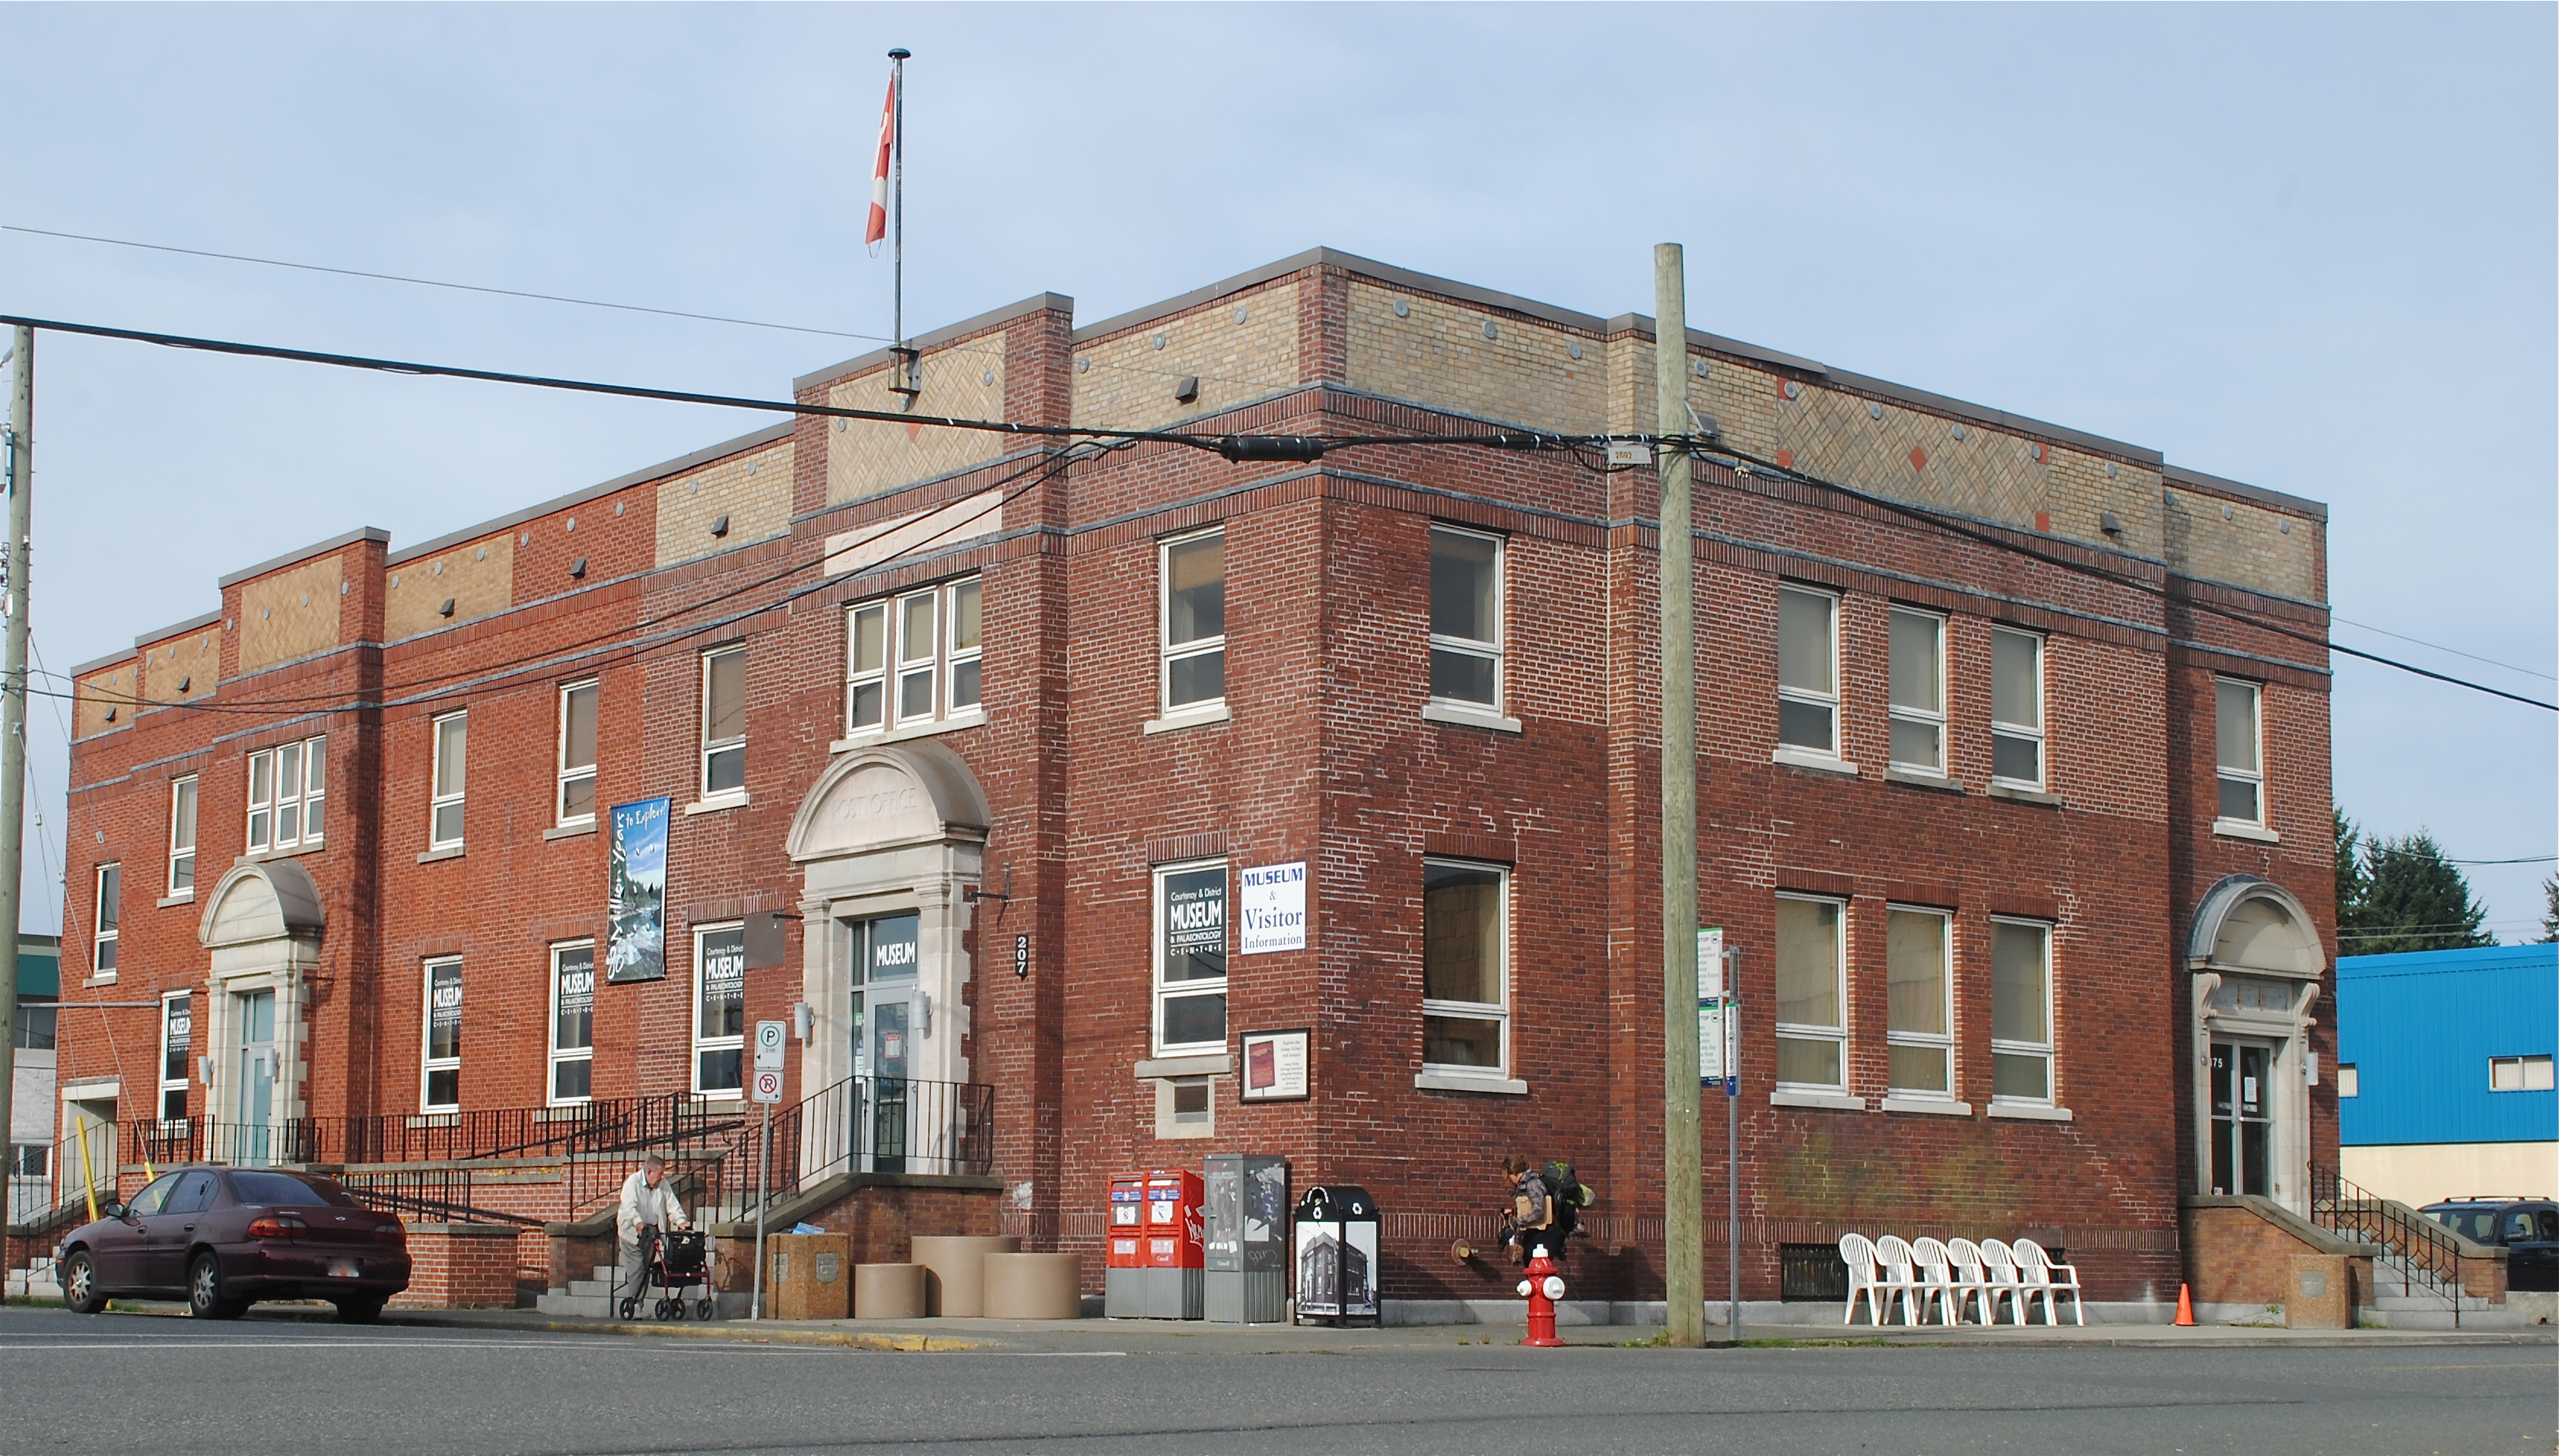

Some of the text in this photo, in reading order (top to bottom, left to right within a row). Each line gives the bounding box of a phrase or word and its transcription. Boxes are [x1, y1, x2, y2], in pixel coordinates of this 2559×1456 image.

[625, 799, 667, 831] to Explore!
[832, 787, 917, 822] POST OFFICE
[612, 812, 627, 865] Years
[1245, 867, 1302, 887] MUSEUM
[1171, 886, 1221, 901] Courtenay & District
[1269, 891, 1276, 901] &
[610, 869, 626, 944] Million
[1171, 900, 1222, 930] MUSEUM
[1245, 906, 1302, 930] Visitor
[1170, 930, 1222, 944] & PALAEONTOLOGY
[1245, 933, 1302, 949] Information
[876, 942, 915, 967] MUSEUM
[1017, 936, 1026, 974] 207
[706, 955, 743, 980] MUSEUM
[561, 971, 594, 995] MUSEUM
[434, 987, 463, 1008] MUSEUM
[170, 1017, 191, 1035] MUSEUM
[767, 1030, 775, 1043] P
[765, 1078, 773, 1089] P
